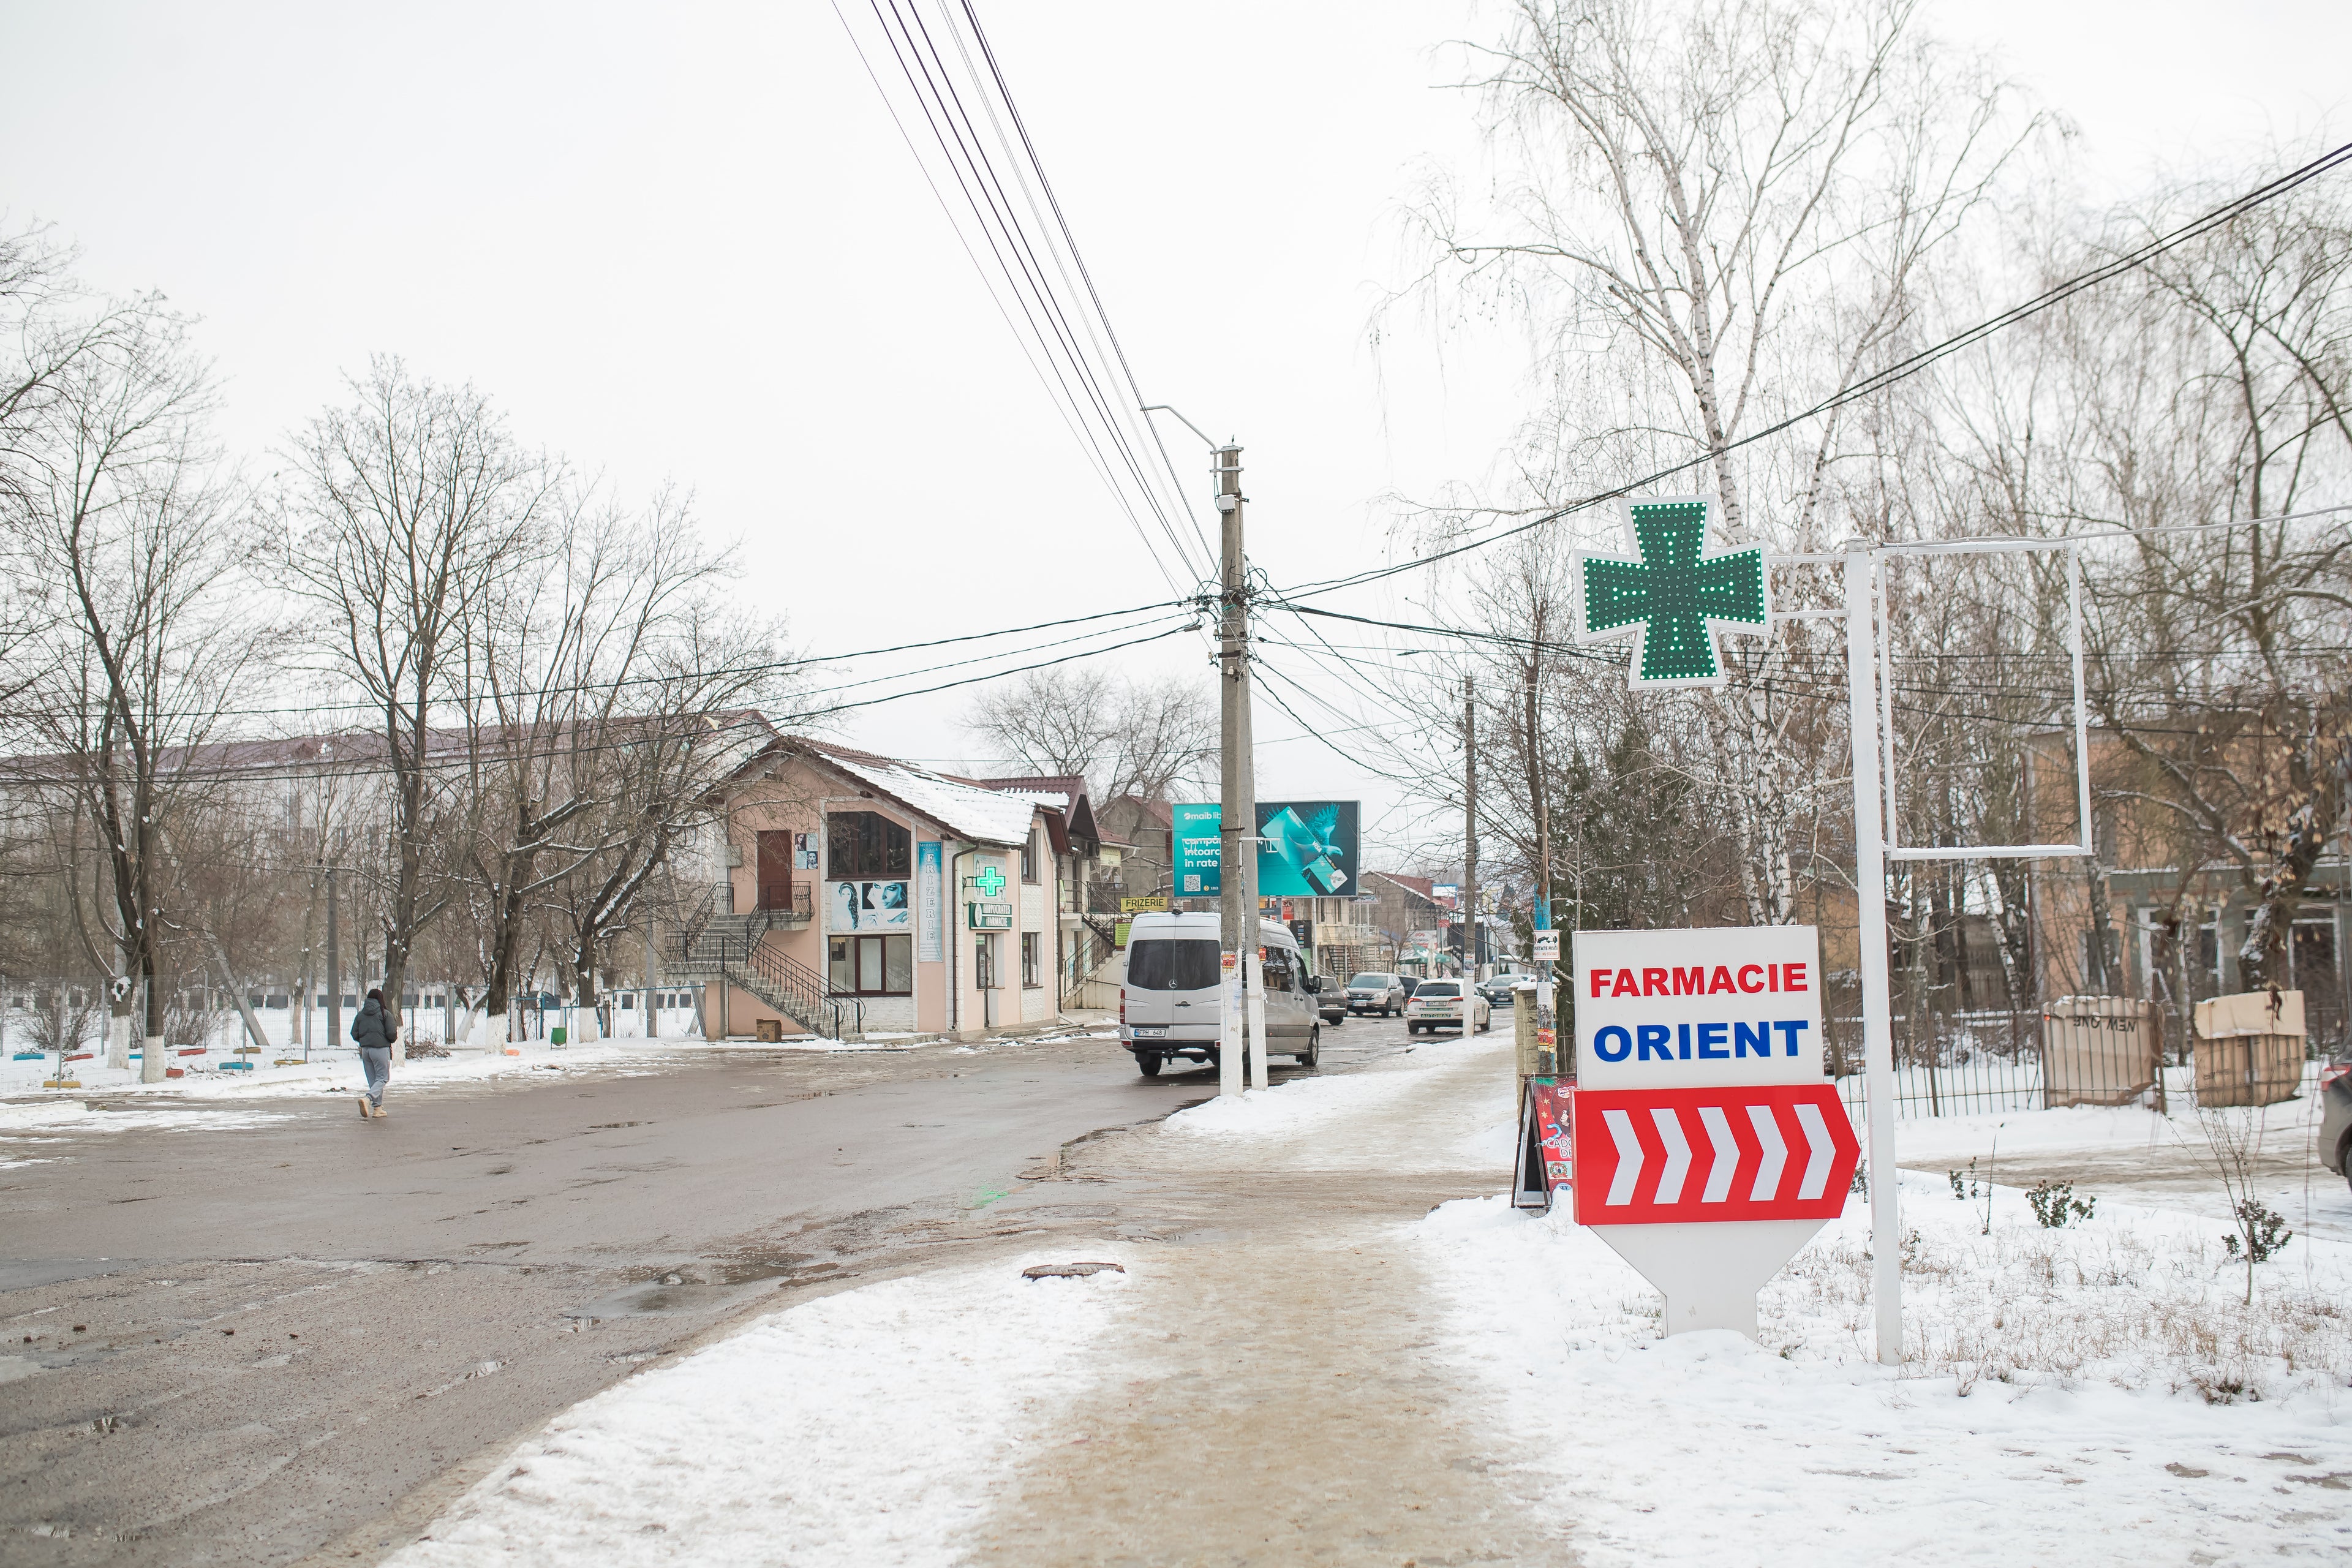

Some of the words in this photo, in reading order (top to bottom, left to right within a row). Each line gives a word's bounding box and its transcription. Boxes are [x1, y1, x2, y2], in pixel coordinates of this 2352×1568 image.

[1312, 840, 1322, 853] VISA
[1185, 859, 1194, 867] în
[926, 853, 935, 940] FRIZERIE
[983, 904, 1011, 914] HIPPOCRATES
[986, 916, 1008, 926] FARMACIE
[1591, 963, 1808, 998] FARMACIE
[2107, 1018, 2136, 1032] NEW
[1594, 1020, 1809, 1062] ORIENT
